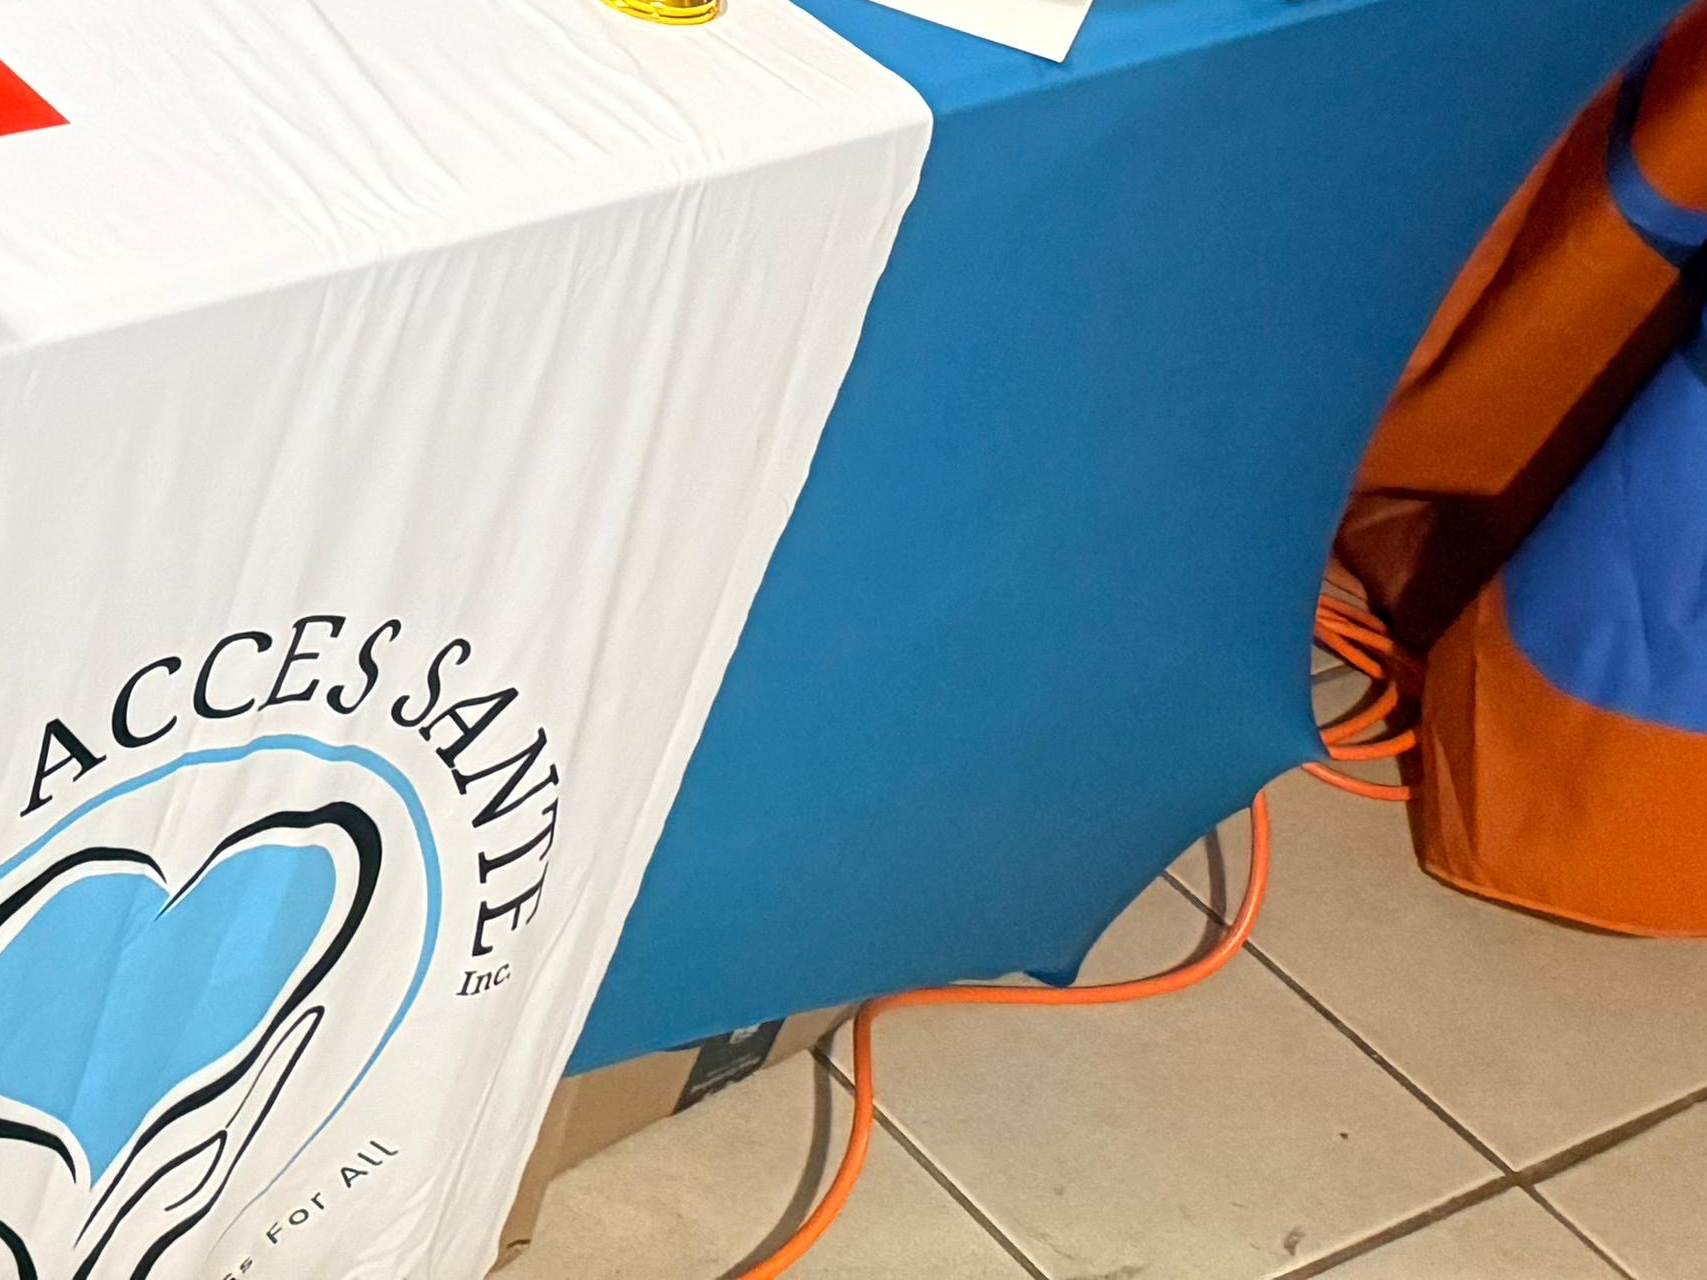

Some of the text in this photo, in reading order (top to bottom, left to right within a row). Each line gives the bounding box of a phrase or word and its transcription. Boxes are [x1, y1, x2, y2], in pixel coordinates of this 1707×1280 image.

[19, 614, 402, 818] ACCES
[389, 638, 562, 957] SANTE
[454, 962, 514, 1000] Inc.
[264, 1139, 402, 1249] For All
